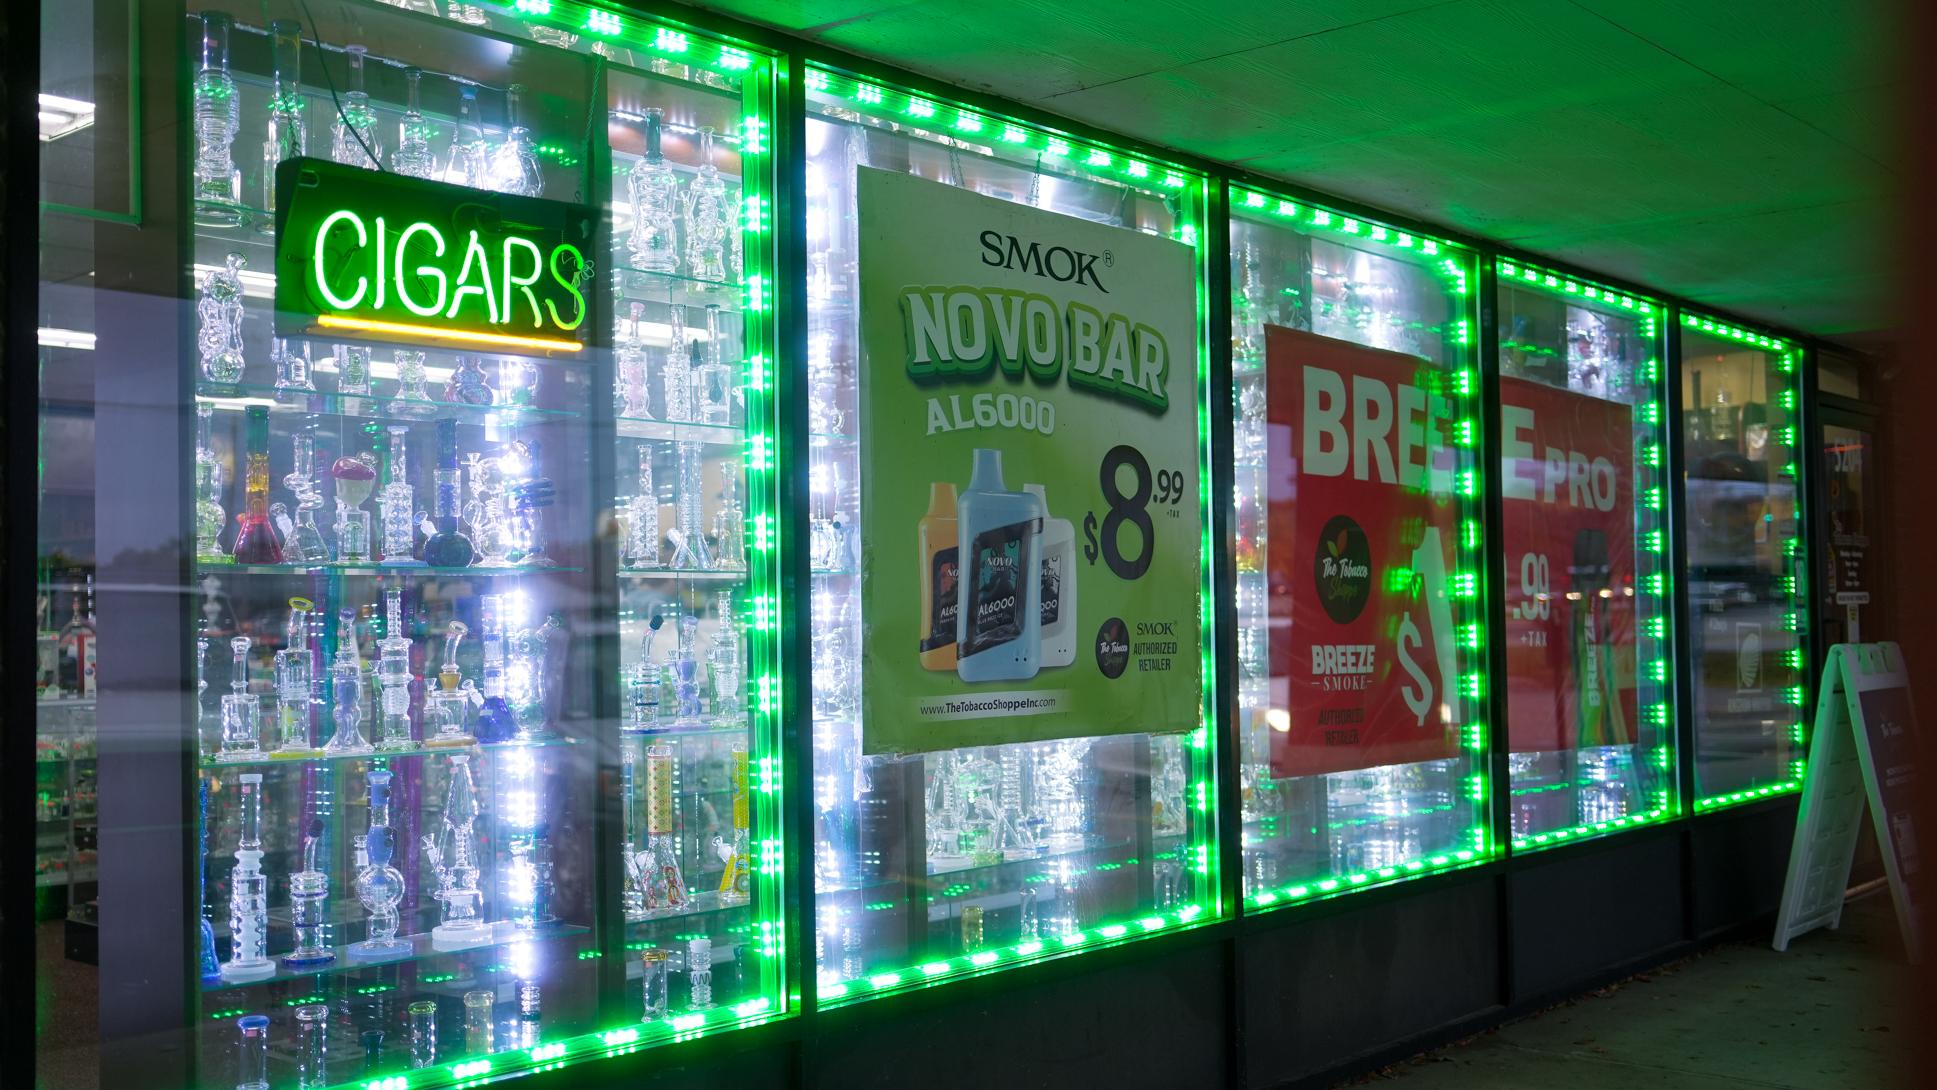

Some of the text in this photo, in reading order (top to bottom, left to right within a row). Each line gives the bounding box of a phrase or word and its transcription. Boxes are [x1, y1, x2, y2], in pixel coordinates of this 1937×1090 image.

[314, 209, 586, 331] CIGARS
[902, 287, 1167, 408] NOVO BAR
[926, 393, 1056, 436] AL6000
[1303, 365, 1616, 512] BREEE PRO
[1322, 557, 1369, 579] The Tobacco
[978, 596, 1015, 616] AL6000
[1133, 642, 1178, 656] AUTHORIZED
[1520, 631, 1547, 648] +TAX
[1138, 658, 1171, 672] RETAILER
[1312, 645, 1376, 675] BREEZE
[919, 697, 1057, 716] www.TheTobaccoShoppeInc.com
